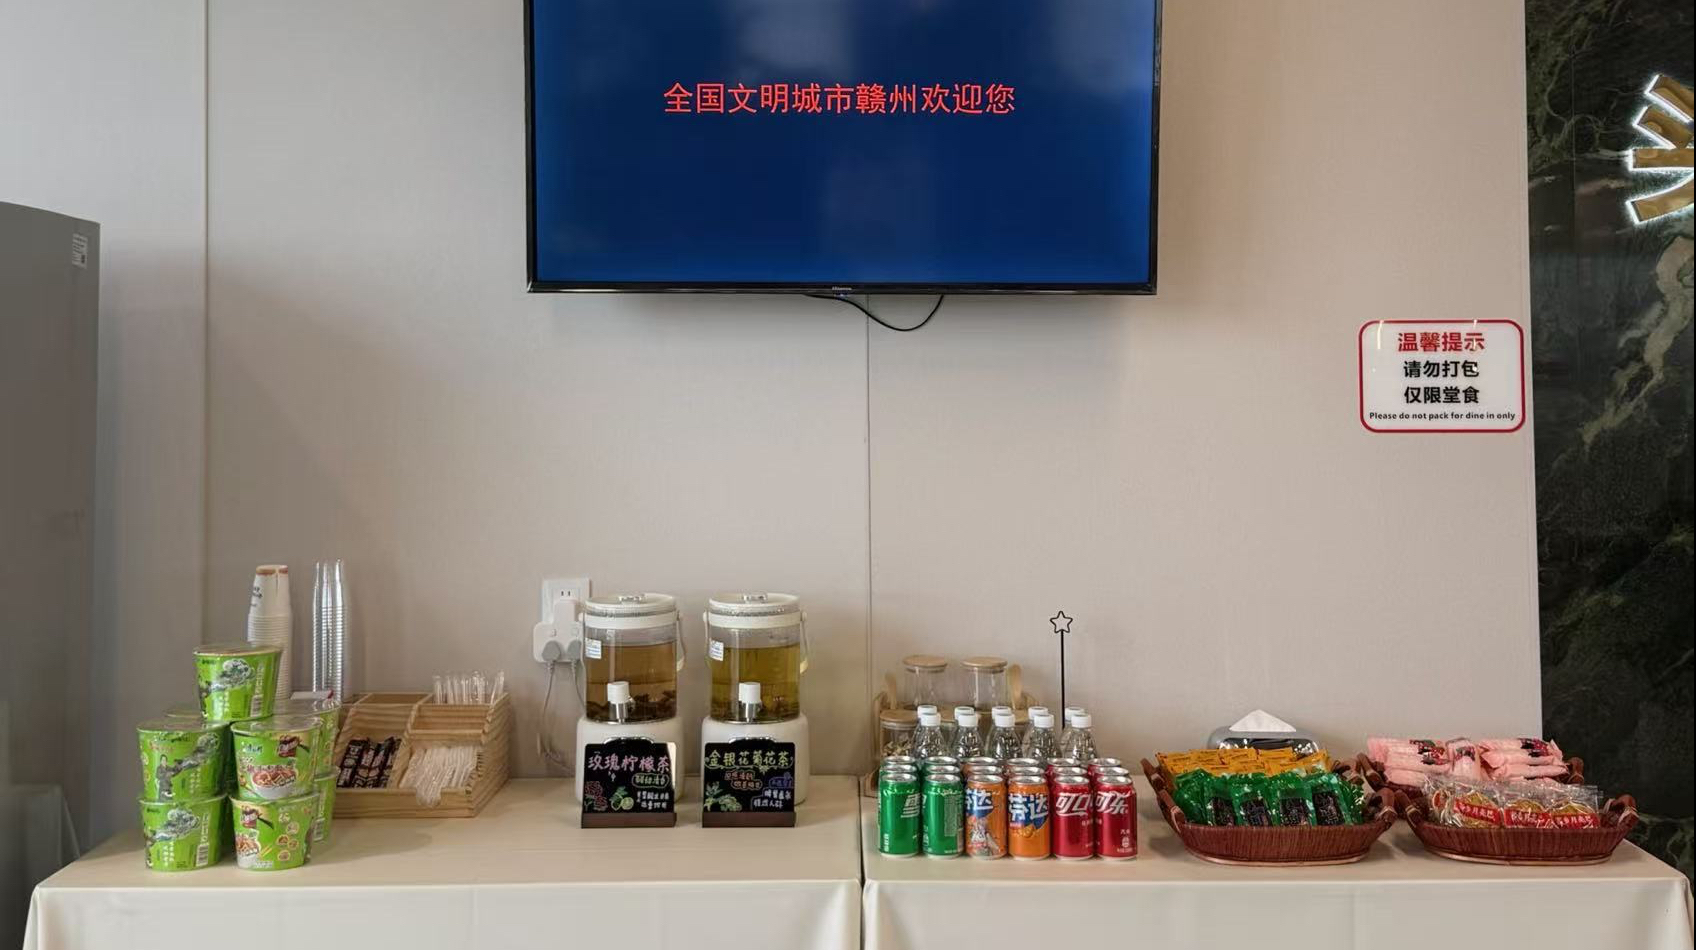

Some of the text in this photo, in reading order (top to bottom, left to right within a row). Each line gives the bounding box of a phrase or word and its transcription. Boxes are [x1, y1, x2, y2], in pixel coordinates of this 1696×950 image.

[663, 82, 1016, 114] 全国文明城市赣州欢迎您
[1397, 332, 1485, 352] 温馨提示
[1403, 360, 1480, 378] 请勿打包
[1404, 386, 1480, 404] 仅限堂食
[1370, 412, 1396, 420] Please
[1399, 412, 1409, 420] do
[1429, 412, 1448, 421] pack
[1451, 412, 1463, 420] for
[1466, 412, 1484, 420] dine
[1487, 412, 1494, 420] in
[1497, 412, 1515, 421] only
[588, 753, 670, 774] 玫瑰柠檬茶
[708, 749, 790, 767] 金银花菊花茶
[1009, 793, 1049, 822] 芬达
[1055, 792, 1091, 817] 可口
